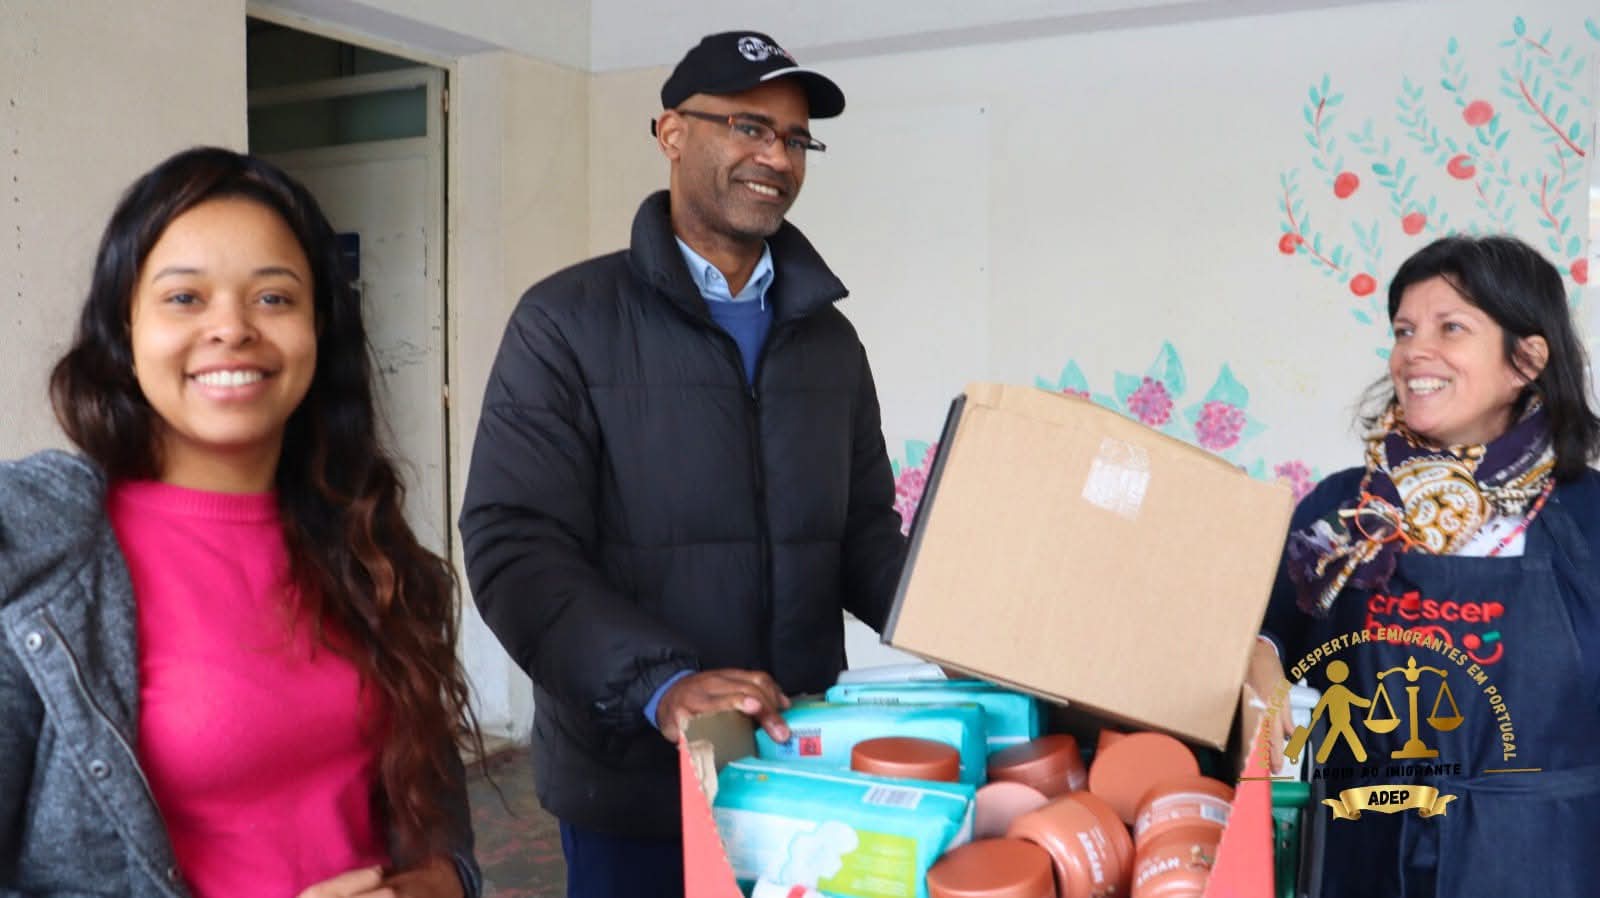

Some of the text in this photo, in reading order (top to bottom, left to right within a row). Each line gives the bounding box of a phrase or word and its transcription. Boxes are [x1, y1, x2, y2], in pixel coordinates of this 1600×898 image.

[1367, 591, 1504, 623] crescer
[1076, 832, 1103, 885] ARGAN
[1136, 857, 1180, 888] ARGAN
